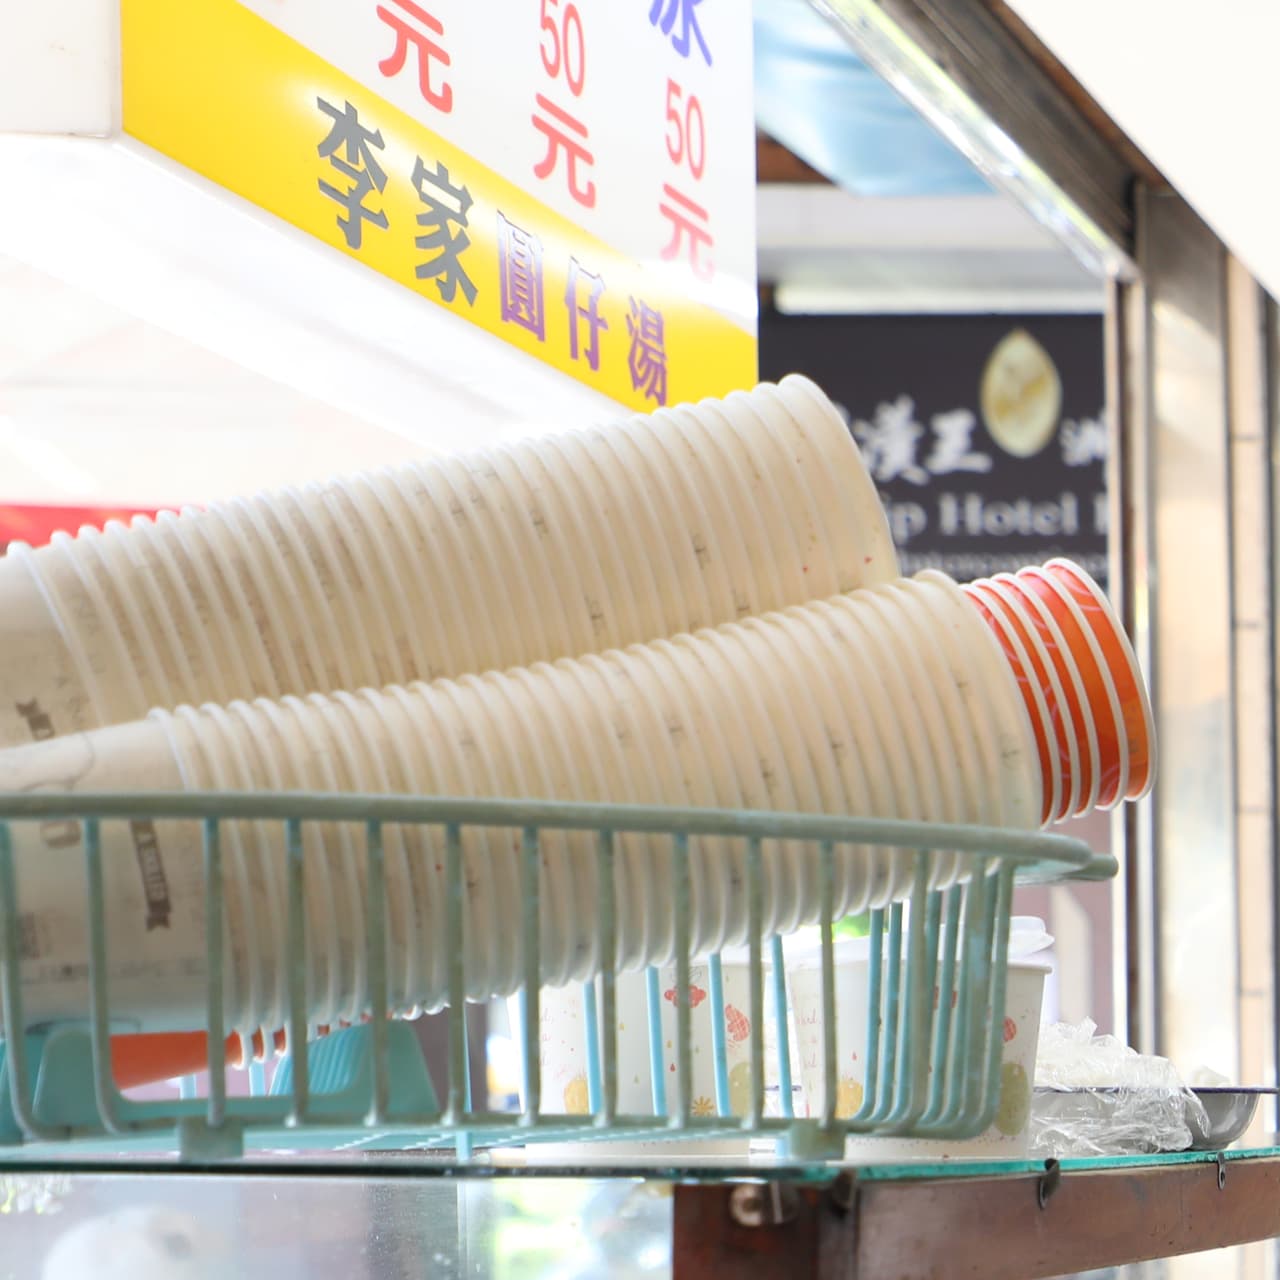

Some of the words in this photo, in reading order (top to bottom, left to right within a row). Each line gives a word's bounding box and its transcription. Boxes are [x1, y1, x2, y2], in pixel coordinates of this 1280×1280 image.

[316, 96, 668, 408] 李家圓仔湯
[938, 492, 1079, 537] Hotel
